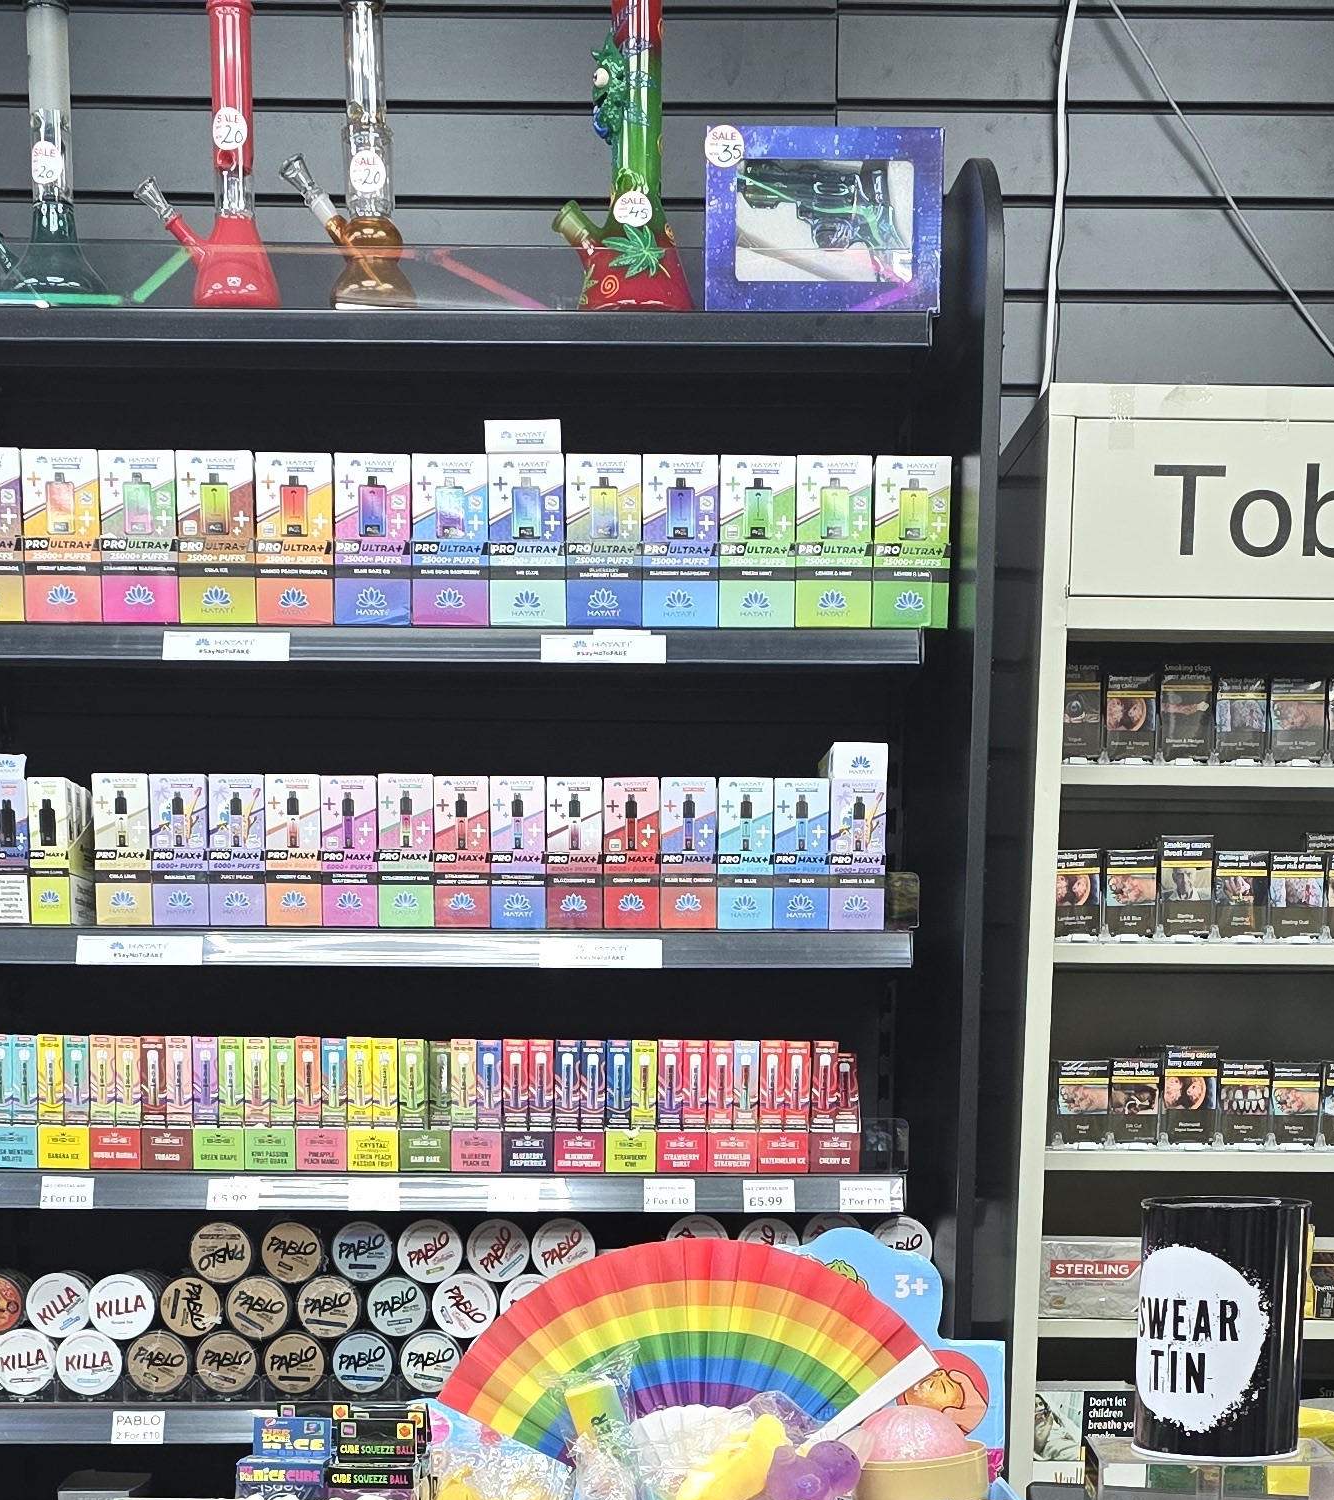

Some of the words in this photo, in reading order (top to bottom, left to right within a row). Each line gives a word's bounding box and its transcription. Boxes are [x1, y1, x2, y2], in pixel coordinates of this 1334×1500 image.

[1055, 1263, 1129, 1275] STERLING
[894, 1274, 929, 1297] 3+
[95, 1295, 147, 1316] KILLA
[1139, 1296, 1239, 1342] SWEAR
[1150, 1350, 1206, 1394] TIN
[1089, 1408, 1123, 1418] children
[116, 1415, 160, 1425] PABLO
[1087, 1419, 1120, 1431] breathe
[116, 1431, 120, 1439] 2
[124, 1431, 138, 1439] For
[140, 1431, 160, 1439] £10
[332, 1474, 351, 1483] CUBE
[353, 1475, 388, 1484] SQUEEZE
[390, 1475, 408, 1484] BALL
